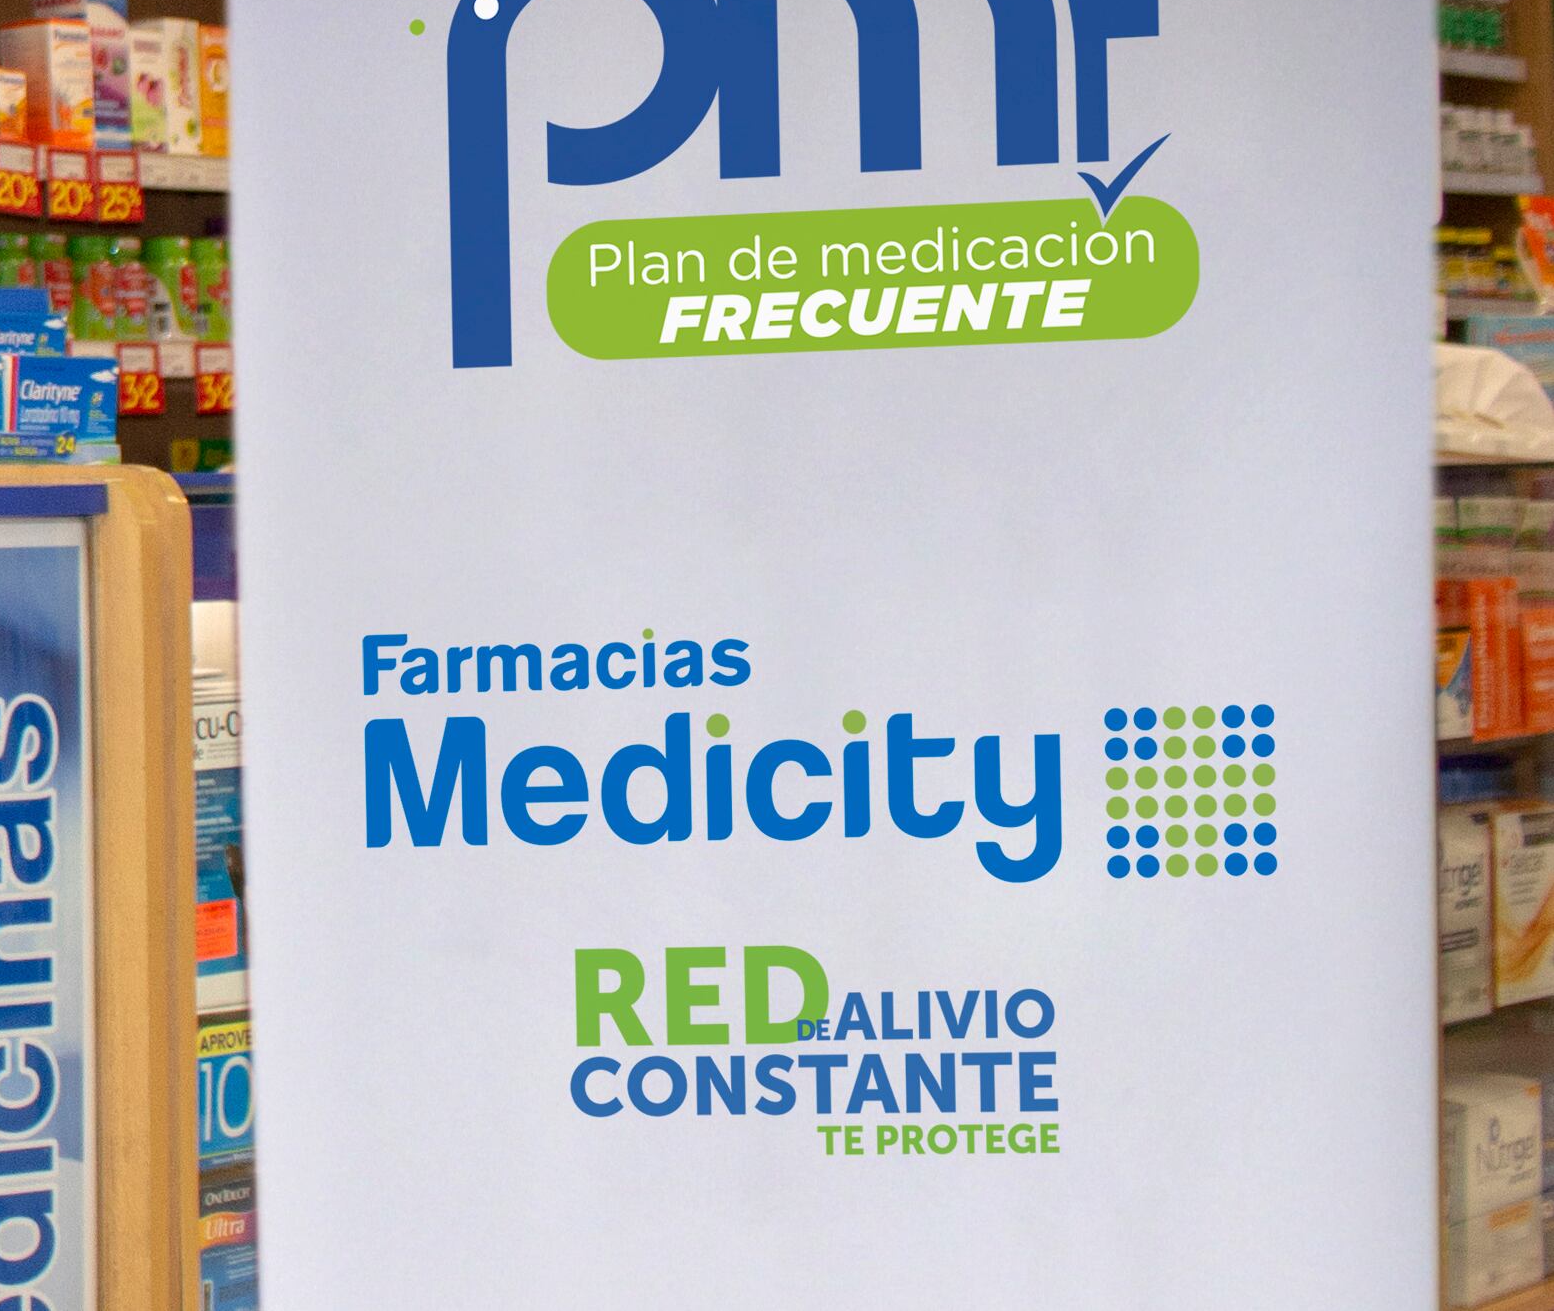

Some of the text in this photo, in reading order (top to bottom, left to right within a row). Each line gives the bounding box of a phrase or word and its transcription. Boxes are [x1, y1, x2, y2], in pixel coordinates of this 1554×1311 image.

[589, 242, 705, 288] Plan
[729, 235, 798, 281] de
[659, 279, 1091, 344] FRECUENTE
[20, 380, 82, 402] Clarityne
[55, 434, 76, 456] 24
[361, 628, 752, 696] Farmacias
[363, 709, 1064, 884] Medicity
[574, 945, 1056, 1047] RED DE ALIVIO
[569, 1050, 1059, 1118] CONSTANTE
[817, 1123, 1061, 1157] TE PROTEGE
